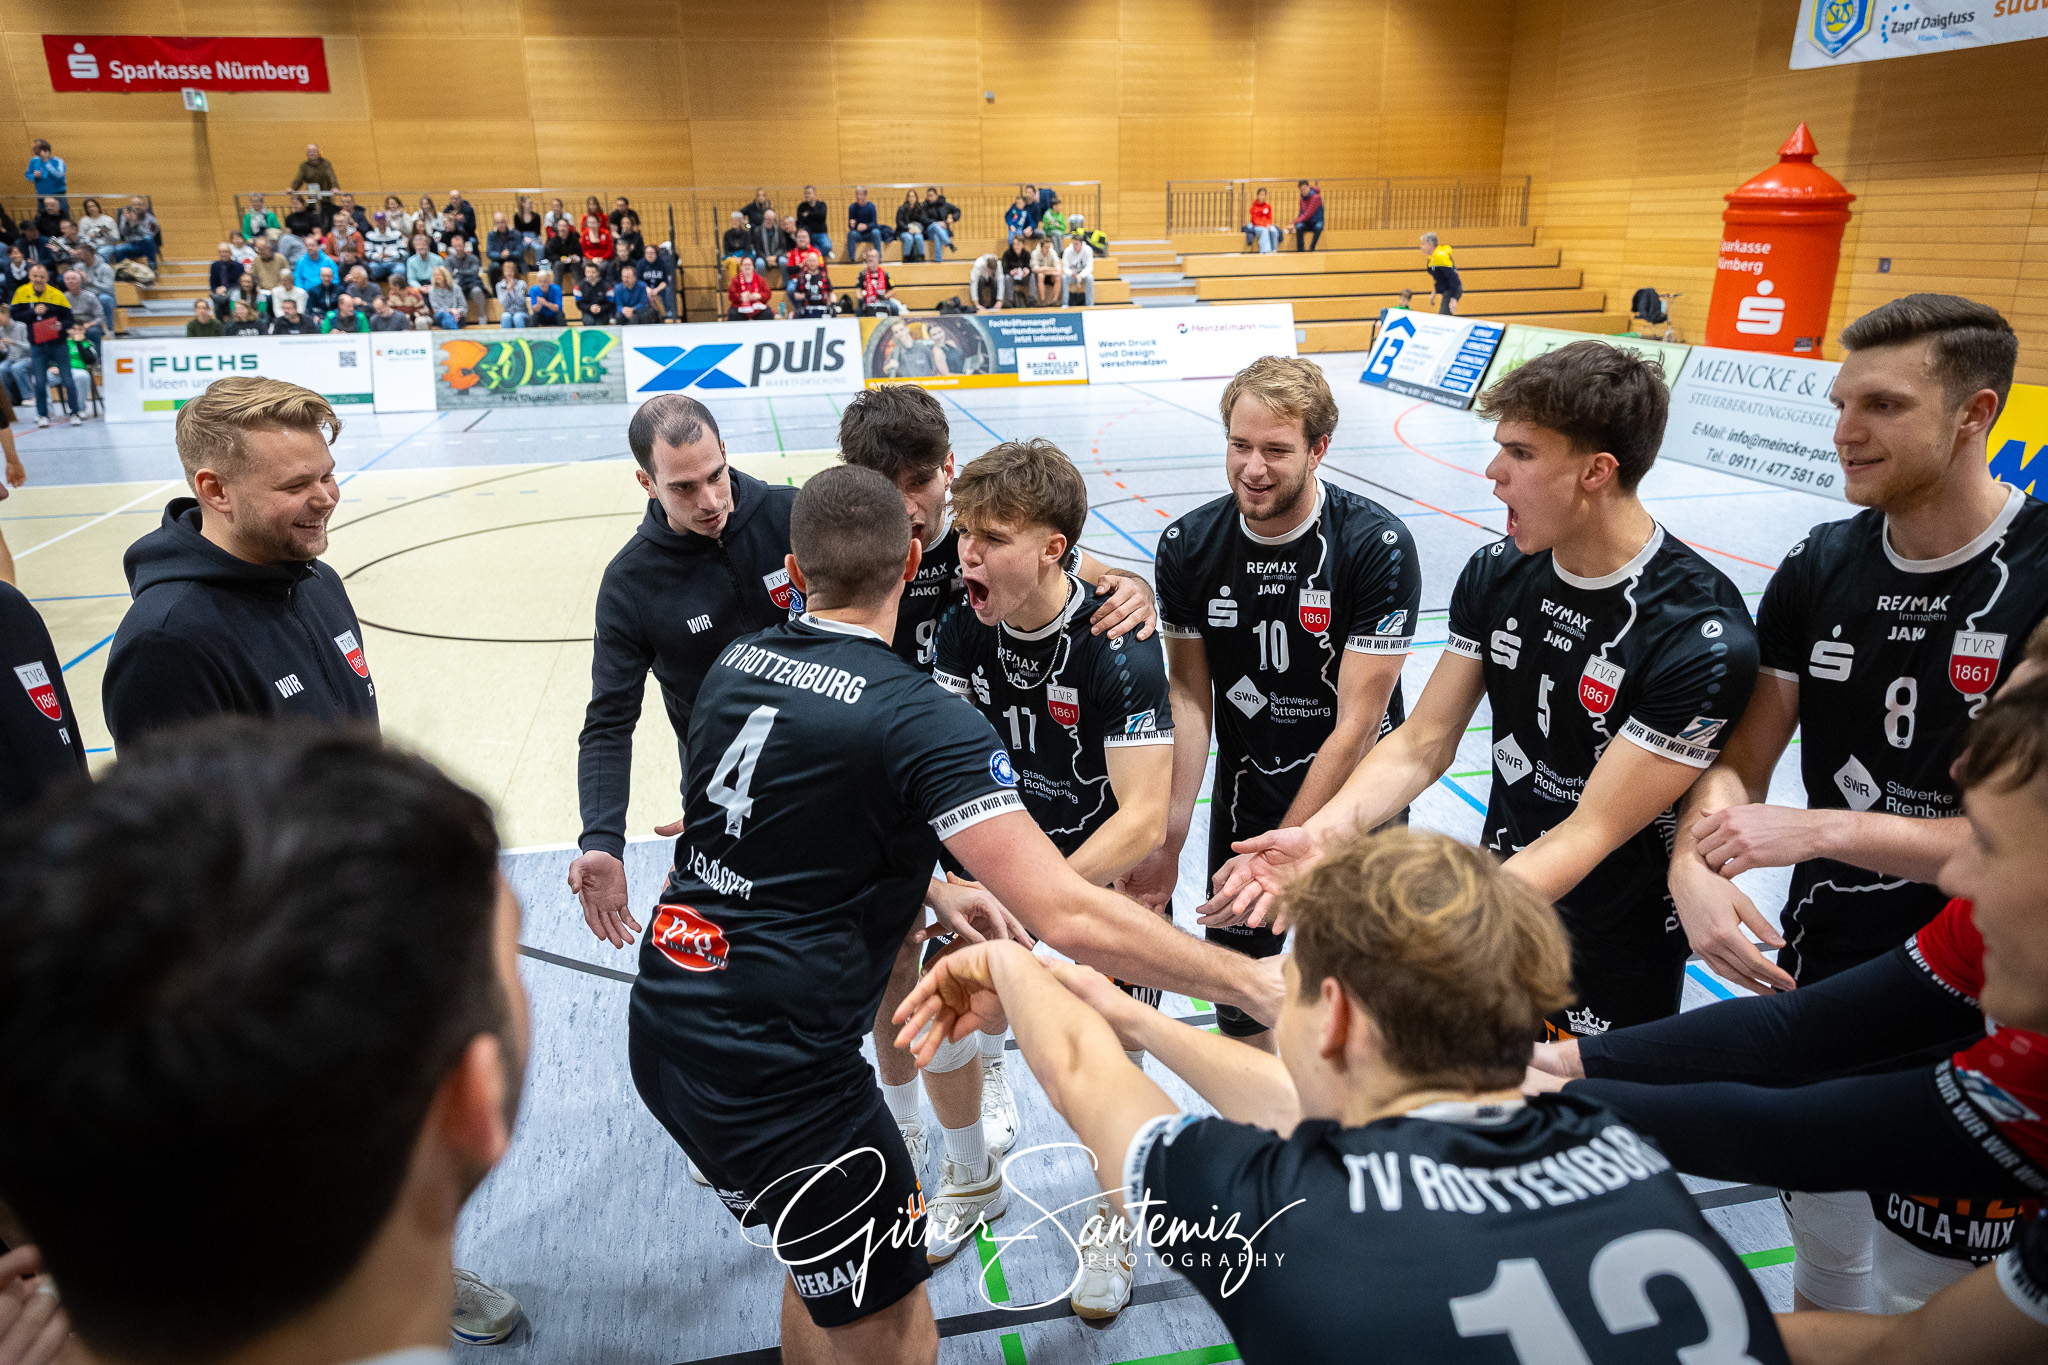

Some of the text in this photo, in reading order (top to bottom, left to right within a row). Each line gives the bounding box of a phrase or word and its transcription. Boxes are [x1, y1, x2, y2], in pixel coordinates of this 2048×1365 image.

[1890, 17, 1920, 35] Zapf
[1920, 10, 1976, 31] Daigfuss
[109, 60, 310, 84] Sparkasse Nürnberg
[1098, 338, 1157, 348] Wenn Druck
[750, 327, 845, 387] puls
[1099, 348, 1156, 359] und Design
[1100, 358, 1168, 368] verschmelzen
[150, 354, 259, 373] FUCHS
[150, 378, 188, 390] Ideen
[1691, 358, 1796, 393] MEINCKE
[1797, 372, 1816, 397] &
[1688, 391, 1838, 430] STEUERBERATUNGSGESELL
[1692, 421, 1839, 463] E-Mail: info@meincke-part
[1728, 454, 1758, 472] 0911
[1766, 462, 1790, 479] 477
[1790, 466, 1814, 484] 581
[1816, 472, 1835, 489] 60
[918, 562, 948, 580] MAX
[1247, 561, 1297, 575] RE/MAX
[768, 571, 789, 587] TVR
[775, 589, 790, 603] 186
[910, 586, 940, 597] JAKO
[1257, 583, 1286, 595] JAKO
[1304, 594, 1327, 606] TVR
[686, 614, 713, 634] WIR
[1303, 613, 1328, 625] 1861
[1540, 598, 1592, 632] RE/MAX
[340, 636, 356, 650] TVR
[915, 618, 937, 665] 9
[1252, 619, 1290, 673] 10
[1357, 637, 1372, 649] WIR
[1373, 640, 1389, 650] WIR
[1390, 640, 1404, 649] WIR
[1454, 638, 1474, 652] WIR
[1961, 636, 1995, 655] TVR
[351, 655, 366, 670] 1861
[22, 668, 47, 684] TVR
[721, 643, 867, 704] TV ROTTENBURG
[1591, 662, 1619, 684] TVR
[1954, 664, 1990, 682] 1861
[274, 673, 305, 699] WIR
[950, 677, 967, 689] WIR
[36, 692, 58, 710] 1861
[1051, 688, 1074, 702] TVR
[1234, 691, 1260, 705] SWR
[1270, 691, 1319, 706] Sadtwerke
[1582, 684, 1610, 707] 1861
[1052, 706, 1076, 719] 1861
[1884, 677, 1917, 749] 8
[1143, 731, 1159, 740] WIR
[1626, 721, 1646, 739] WIR
[1645, 731, 1667, 748] WIR
[1666, 740, 1687, 755] WIR
[1686, 746, 1706, 760] WIR
[1496, 748, 1524, 771] SWR
[706, 704, 780, 839] 4
[1534, 772, 1580, 802] Rottenb
[1843, 776, 1870, 798] SWR
[940, 813, 959, 830] WIR
[957, 803, 981, 820] WIR
[980, 796, 1002, 811] WIR
[1952, 1100, 1989, 1139] WIR
[1981, 1134, 2021, 1169] WIR
[1343, 1152, 1402, 1213] TV
[1887, 1192, 2015, 1249] COLA-MIX
